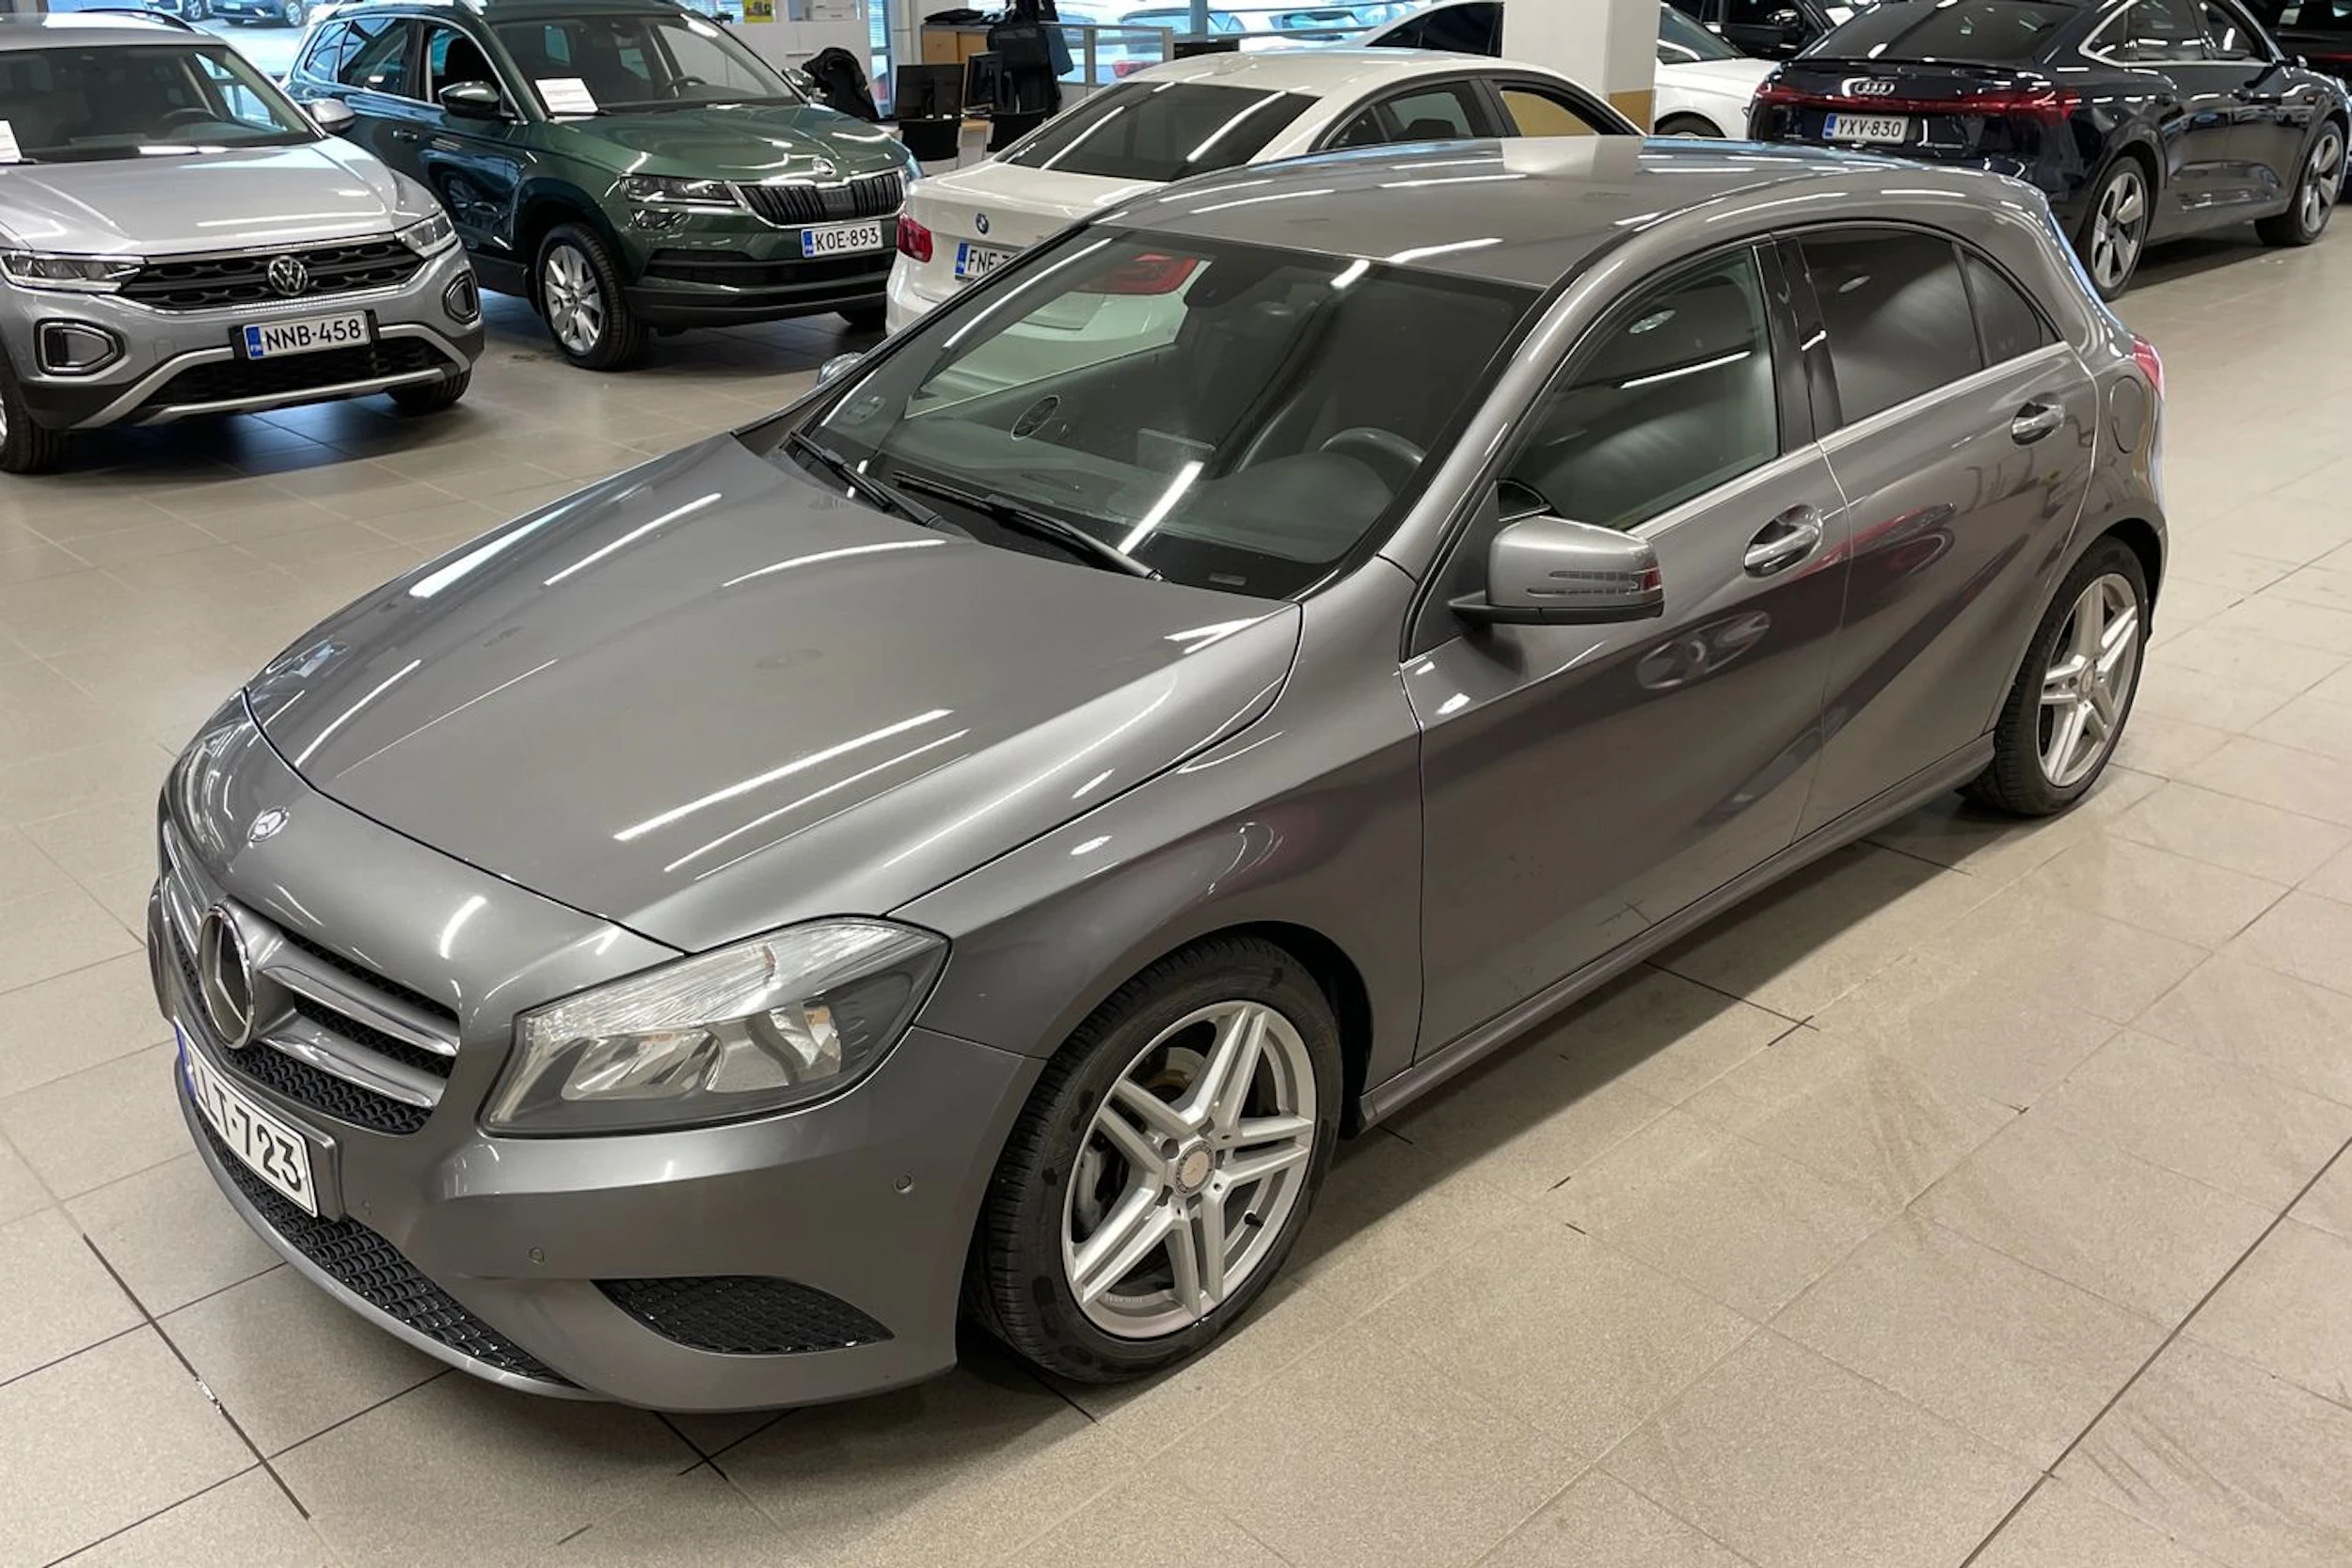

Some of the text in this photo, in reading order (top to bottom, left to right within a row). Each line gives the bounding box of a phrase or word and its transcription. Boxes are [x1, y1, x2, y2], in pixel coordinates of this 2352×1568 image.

[1838, 118, 1901, 137] YXV-830
[815, 226, 879, 251] KOE-893
[264, 318, 361, 351] NNB-458
